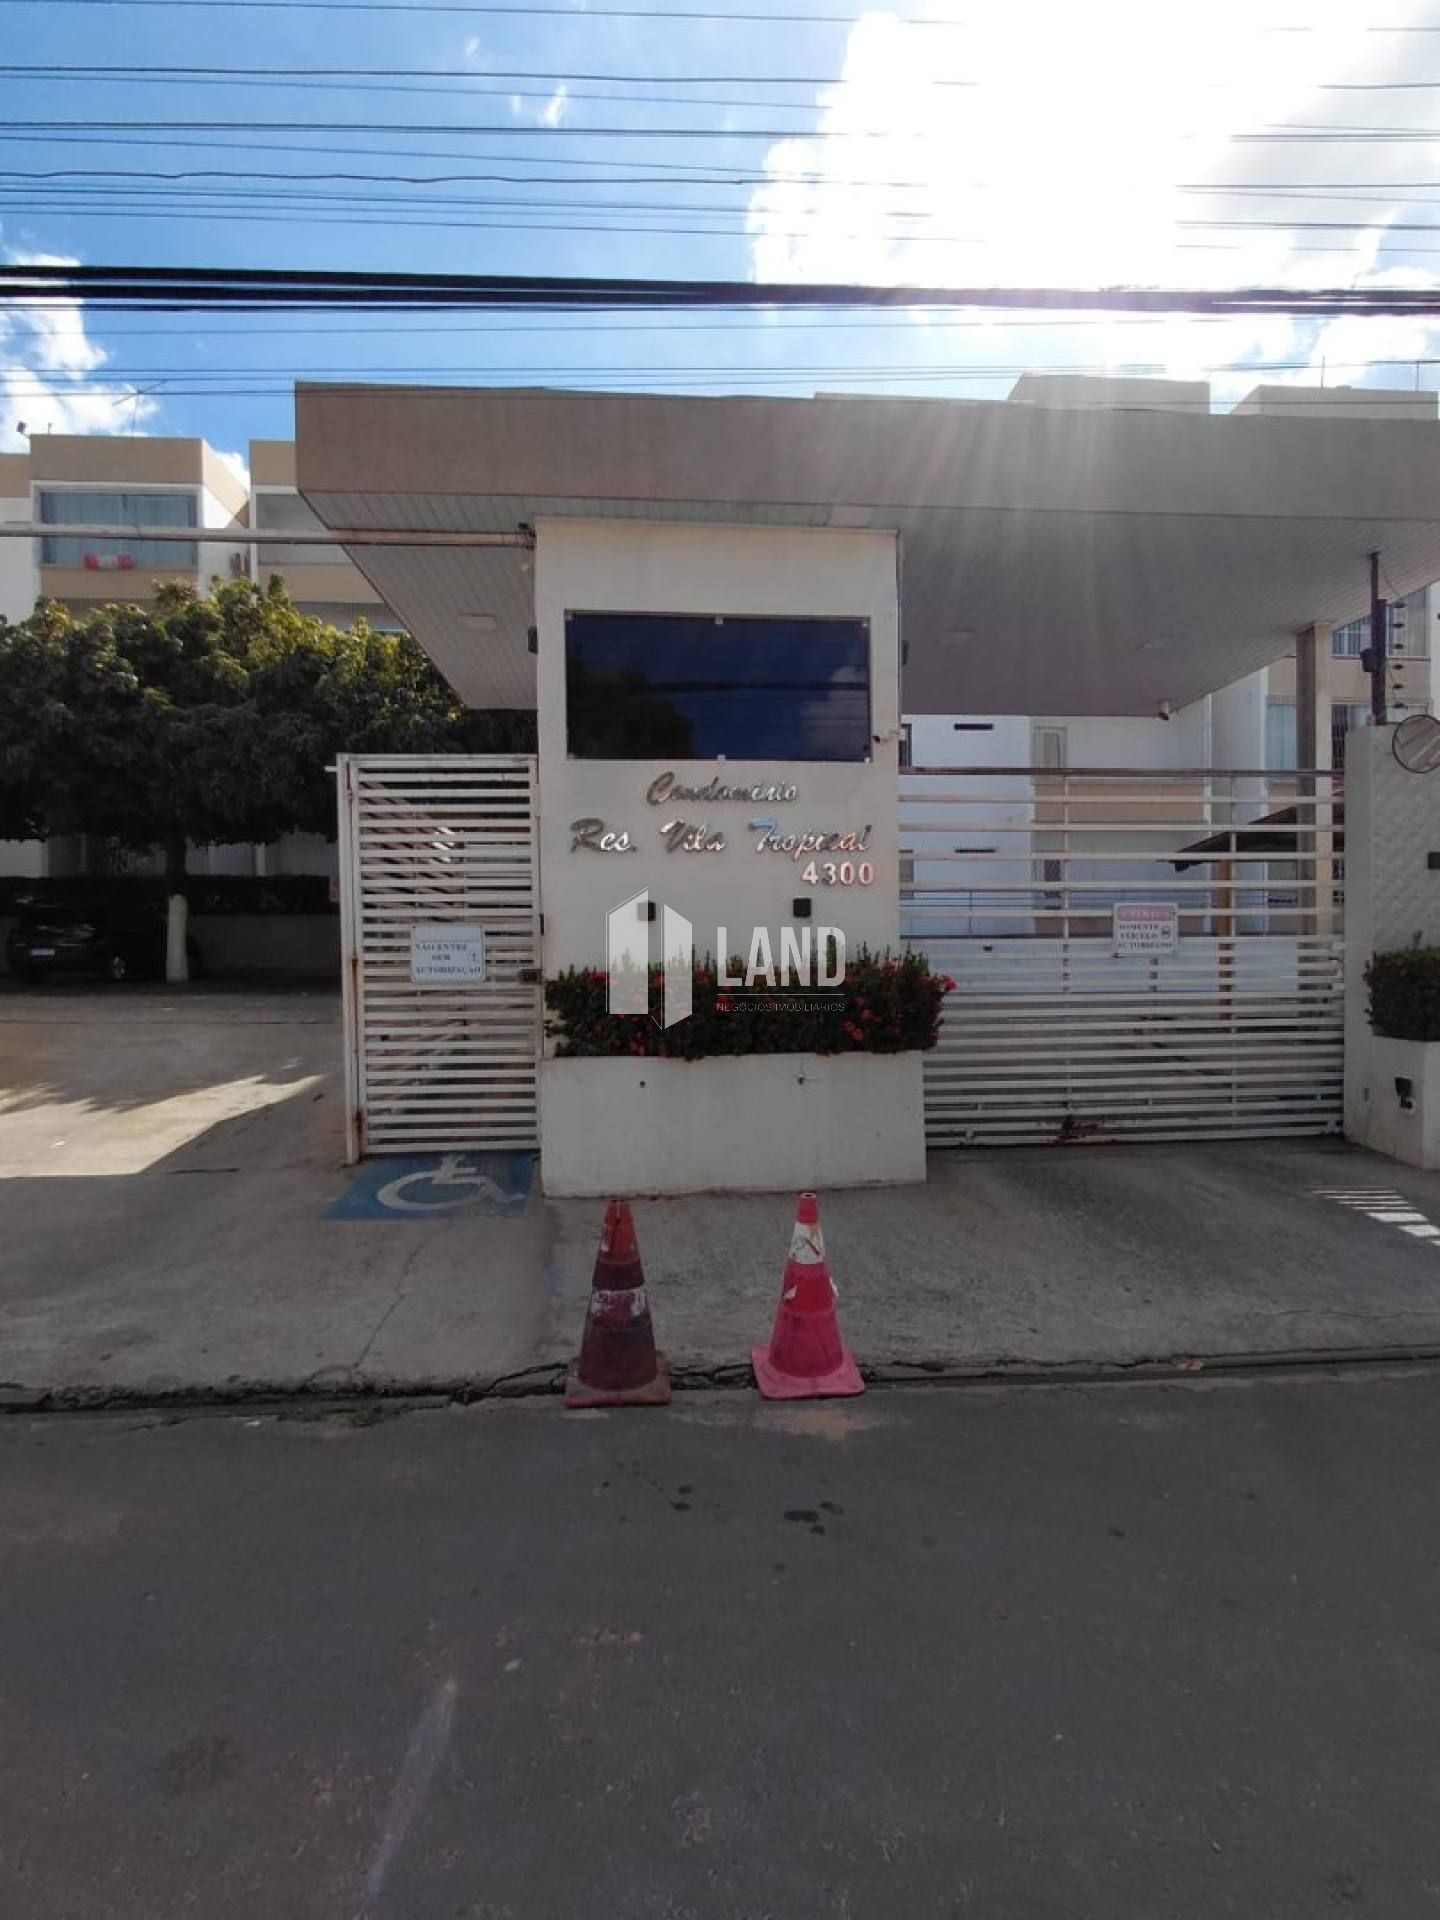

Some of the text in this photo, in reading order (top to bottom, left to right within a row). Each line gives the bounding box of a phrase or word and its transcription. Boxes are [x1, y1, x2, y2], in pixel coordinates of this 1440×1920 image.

[570, 815, 872, 862] Res. Vila Tropical
[801, 860, 875, 885] 4300
